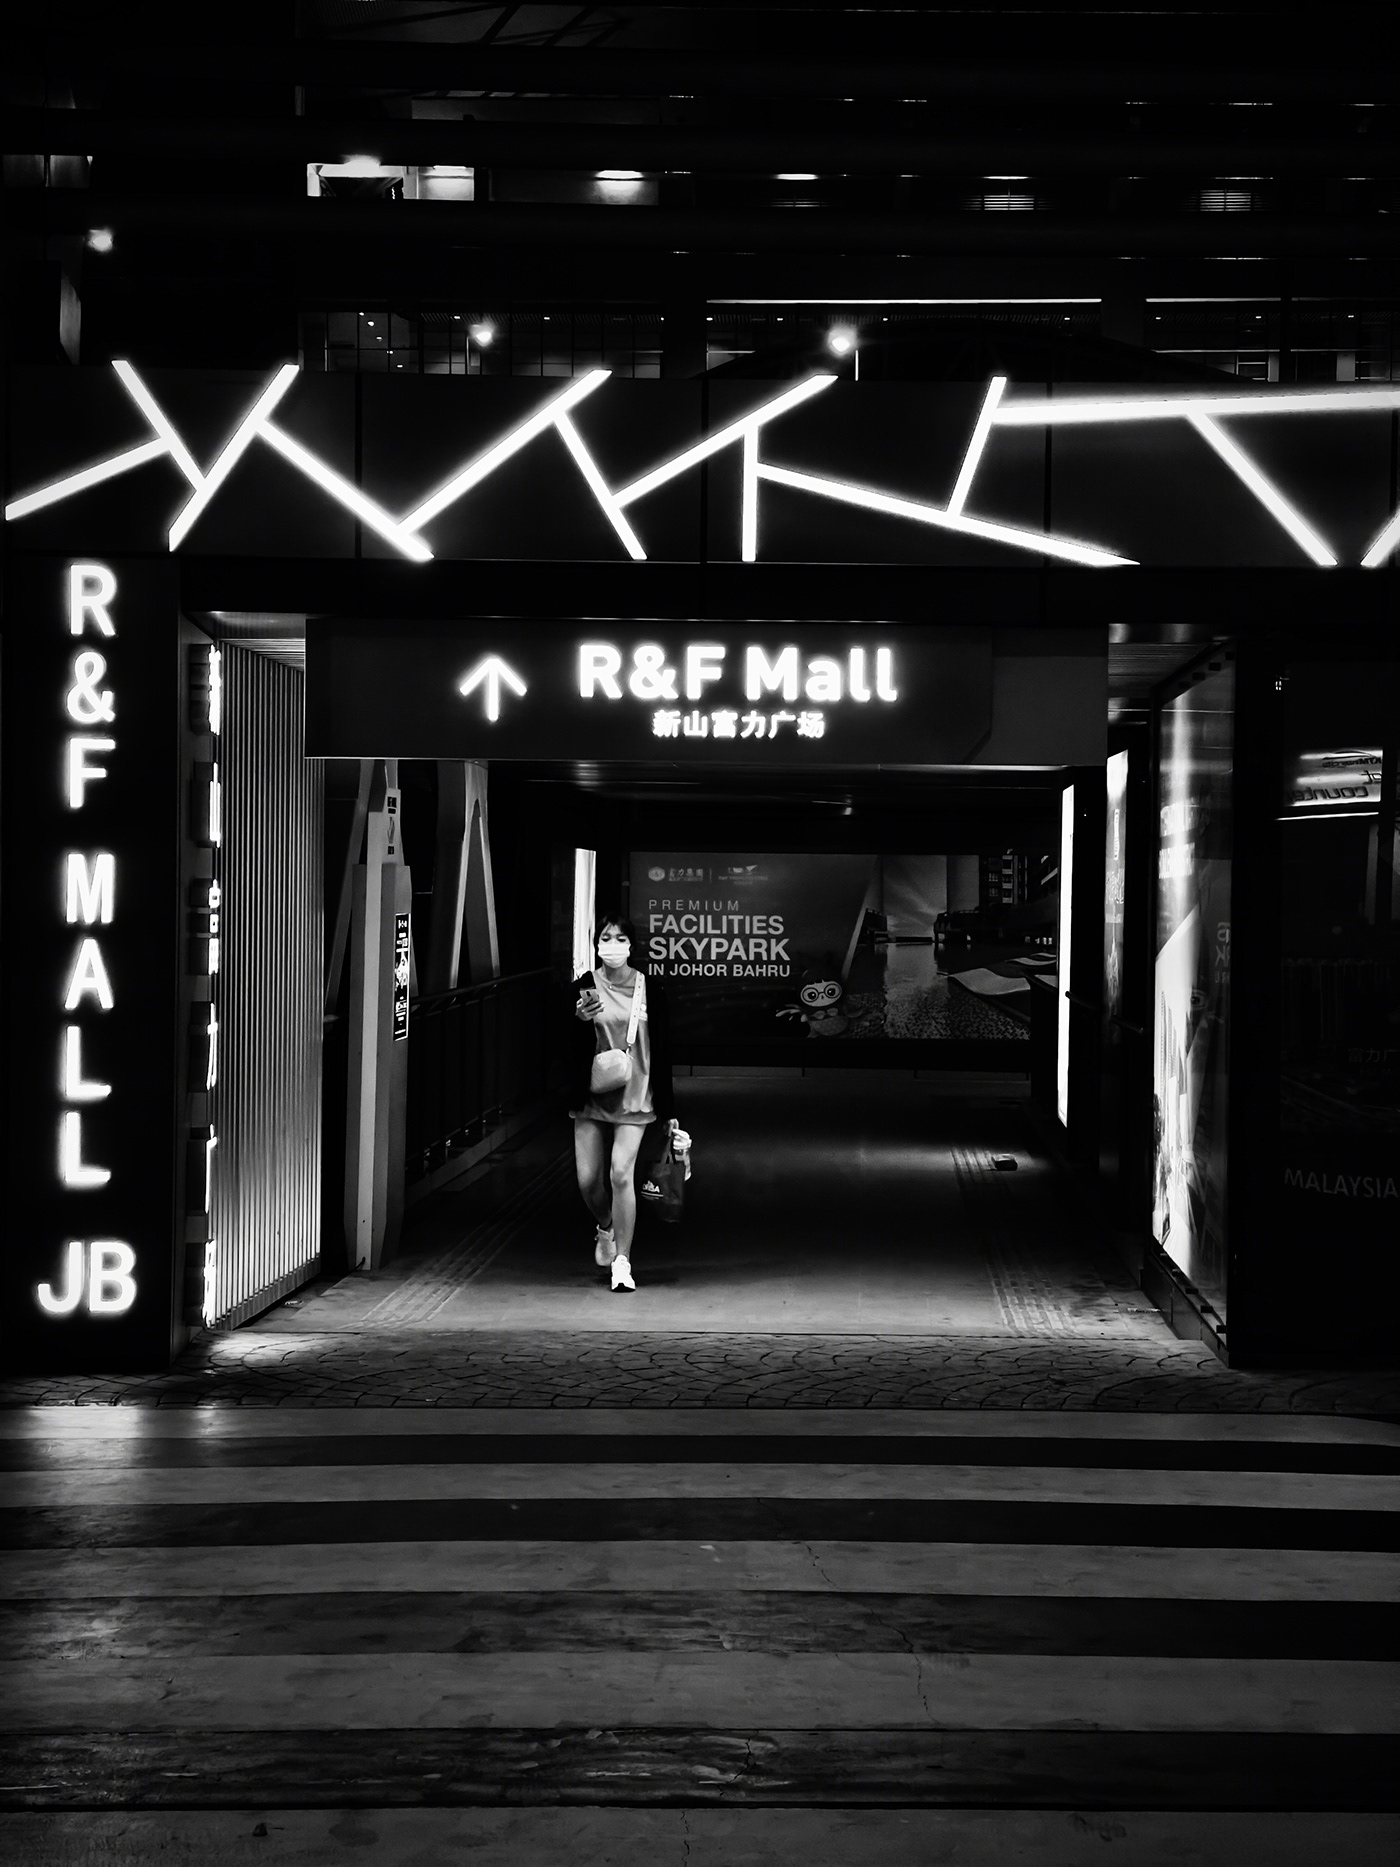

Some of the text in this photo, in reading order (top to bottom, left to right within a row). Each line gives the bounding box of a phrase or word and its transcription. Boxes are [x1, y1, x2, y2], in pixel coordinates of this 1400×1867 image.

[578, 643, 898, 702] R&F Mall
[652, 709, 826, 739] 新山富力广场
[648, 898, 740, 912] PREMIUM
[37, 564, 137, 1313] R&F MALL JB
[648, 913, 785, 936] FACILITIES
[648, 935, 791, 962] SKYPARK
[648, 962, 791, 978] IN JOHOR BAHRU
[1283, 1166, 1400, 1199] MALAYSIA
